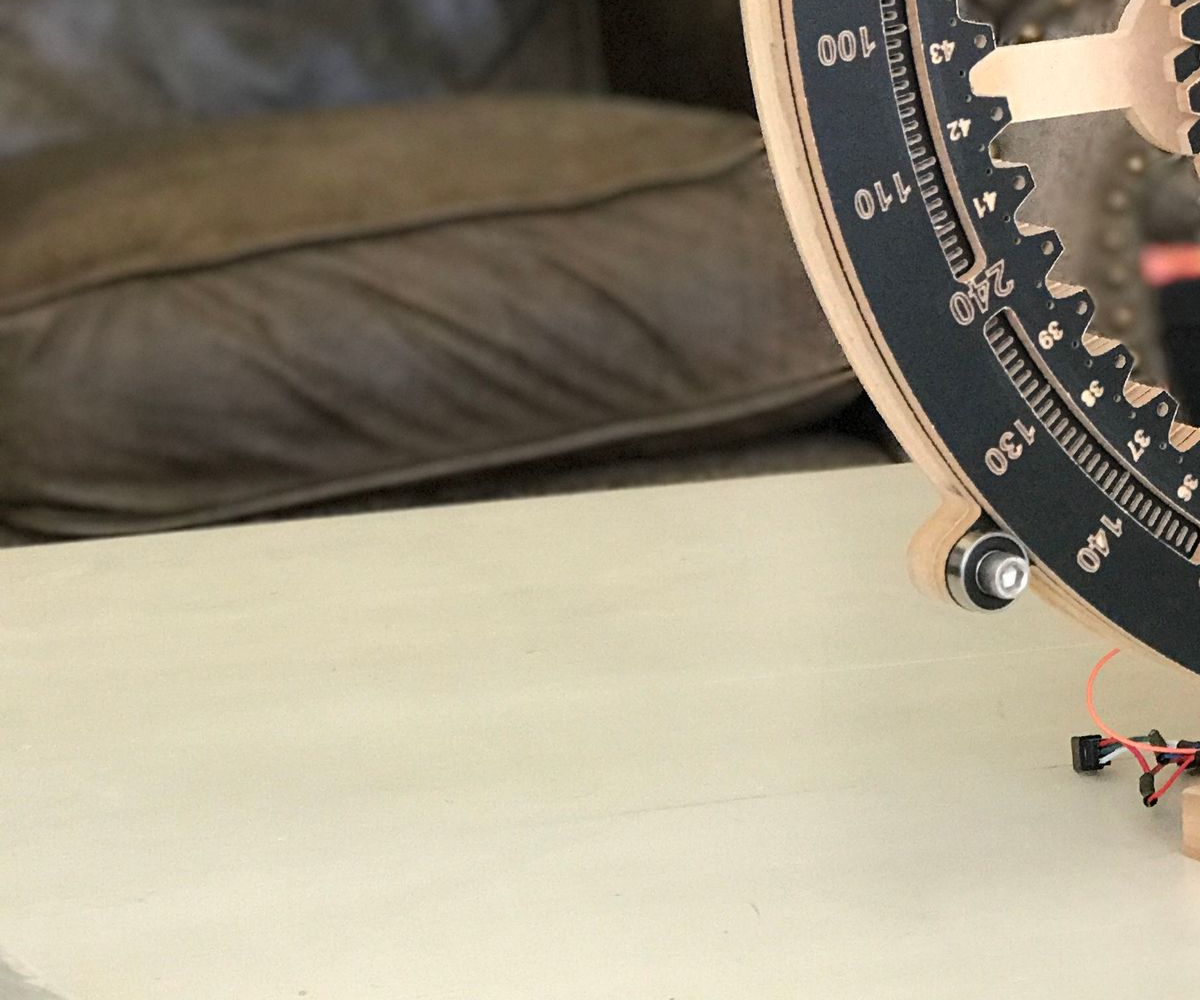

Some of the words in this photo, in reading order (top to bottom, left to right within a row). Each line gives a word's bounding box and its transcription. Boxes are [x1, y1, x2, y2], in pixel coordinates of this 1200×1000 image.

[817, 26, 877, 67] 100
[929, 39, 956, 65] 43
[946, 117, 972, 142] 42
[853, 171, 912, 220] 110
[973, 191, 997, 219] 41
[949, 258, 1014, 326] 240
[1038, 320, 1064, 350] 39
[984, 419, 1036, 476] 130
[1127, 429, 1151, 463] 37
[1076, 514, 1123, 574] 140
